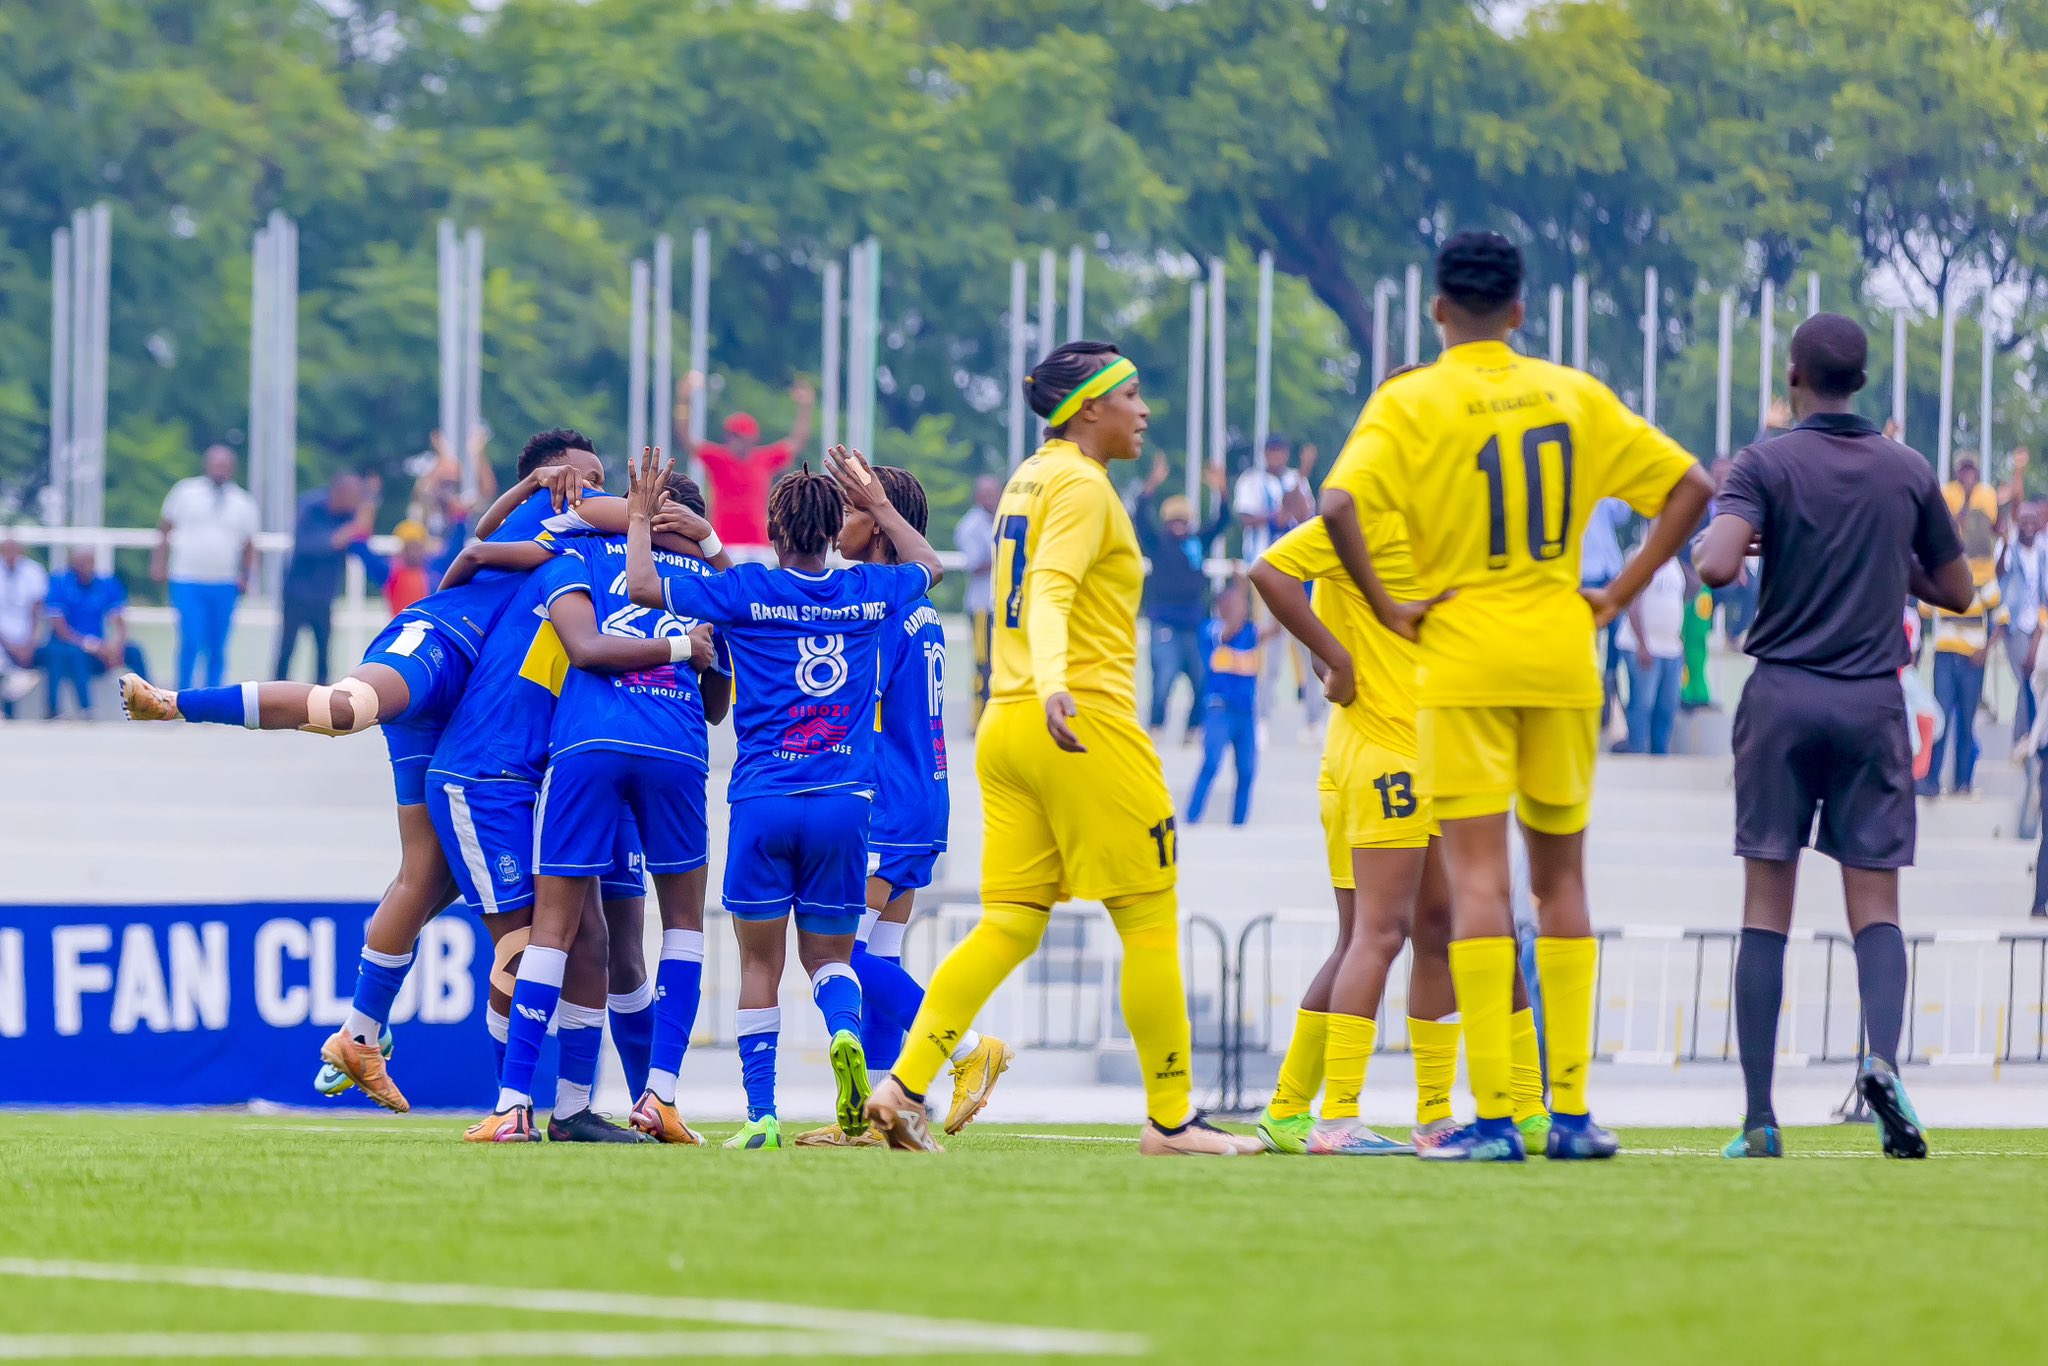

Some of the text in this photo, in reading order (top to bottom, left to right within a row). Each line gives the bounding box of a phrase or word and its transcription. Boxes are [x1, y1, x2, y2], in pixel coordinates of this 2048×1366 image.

[1477, 422, 1573, 570] 10
[651, 551, 700, 573] SPORTS
[750, 601, 887, 622] RAYON SPORTS WFC
[795, 633, 849, 697] 8
[651, 686, 692, 701] HOUSE
[1372, 771, 1417, 819] 13
[52, 920, 230, 1036] FAN
